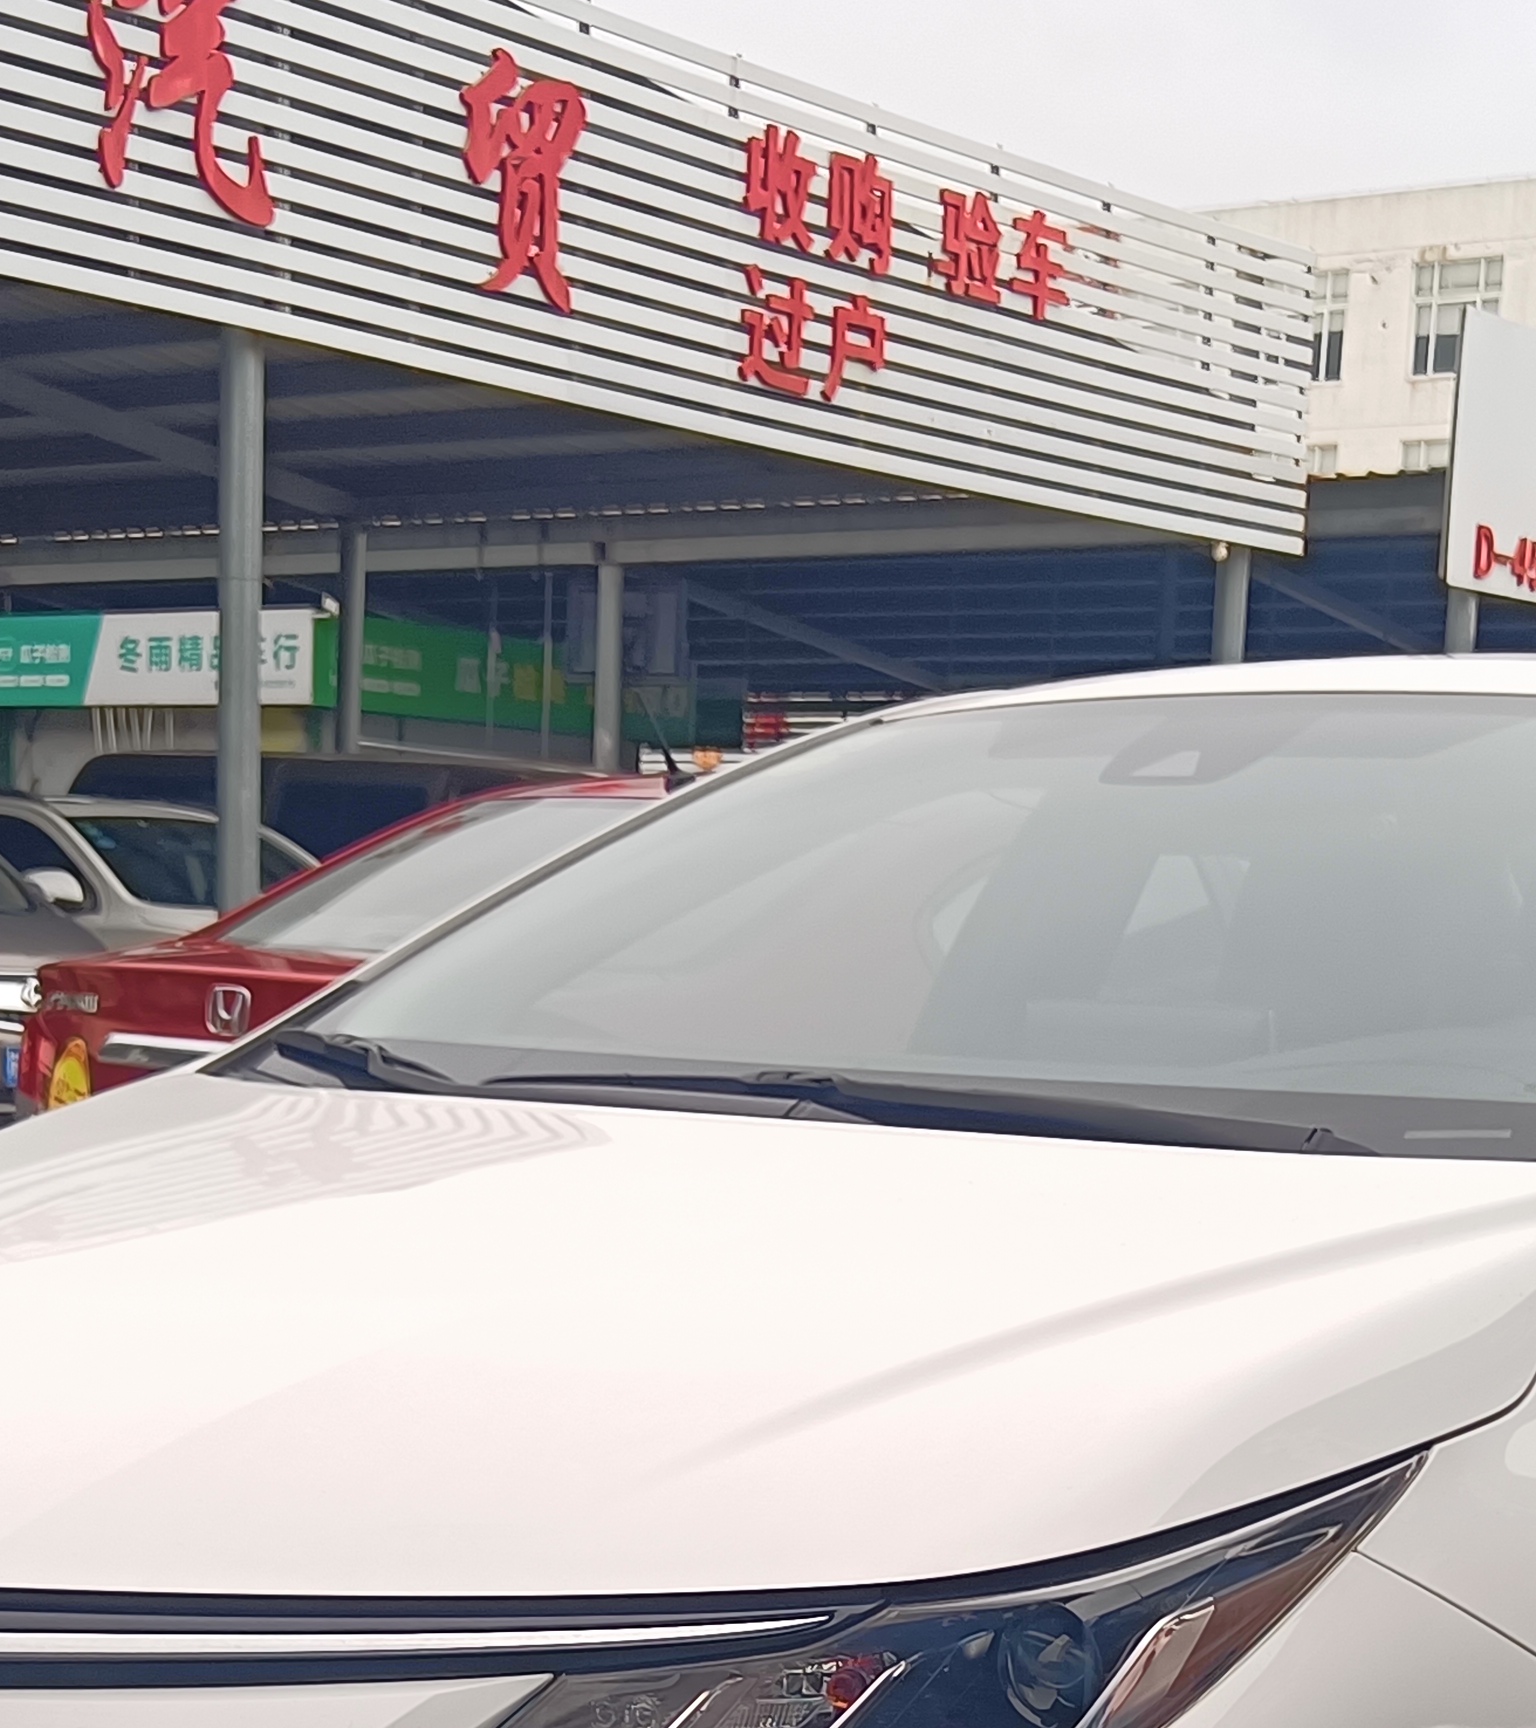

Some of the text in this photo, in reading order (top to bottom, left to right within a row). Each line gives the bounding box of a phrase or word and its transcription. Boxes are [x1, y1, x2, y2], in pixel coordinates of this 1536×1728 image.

[744, 123, 1069, 321] 收购 验车
[737, 264, 888, 402] 过户
[118, 633, 300, 674] 冬雨精行
